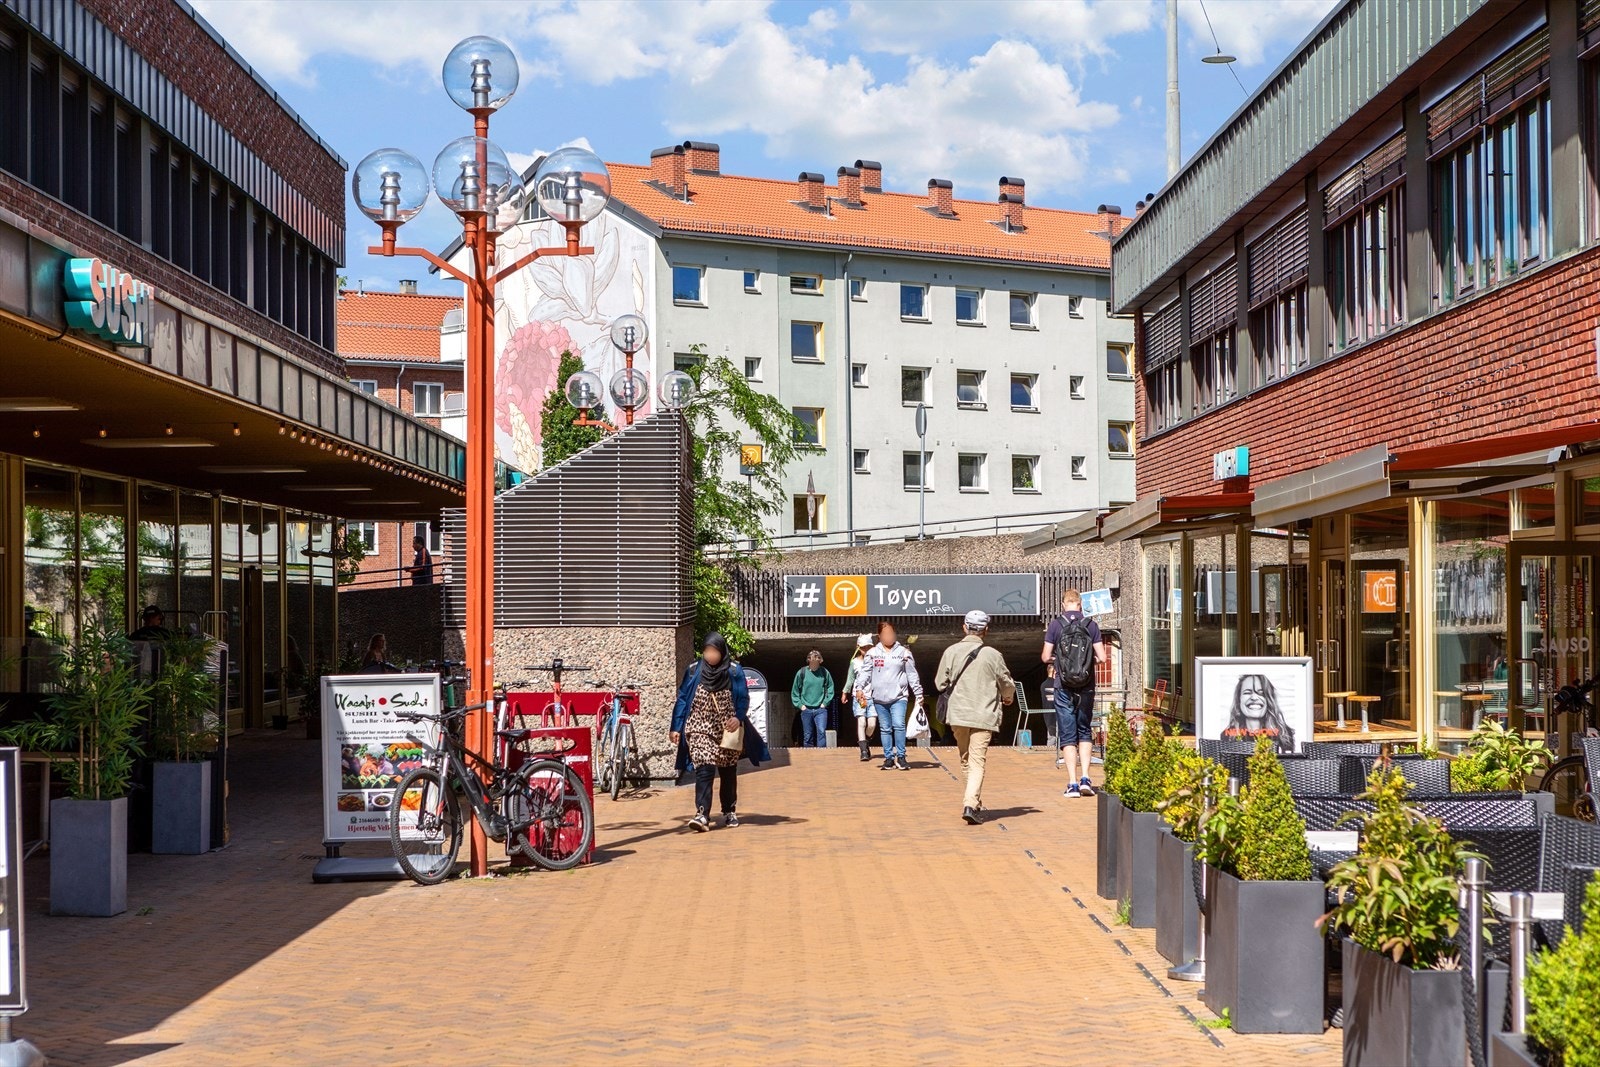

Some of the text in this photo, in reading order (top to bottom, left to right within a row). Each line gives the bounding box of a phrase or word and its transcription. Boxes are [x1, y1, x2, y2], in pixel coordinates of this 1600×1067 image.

[90, 257, 155, 348] SUSHI
[874, 584, 941, 610] Tøyen
[347, 824, 377, 833] Hjertelig
